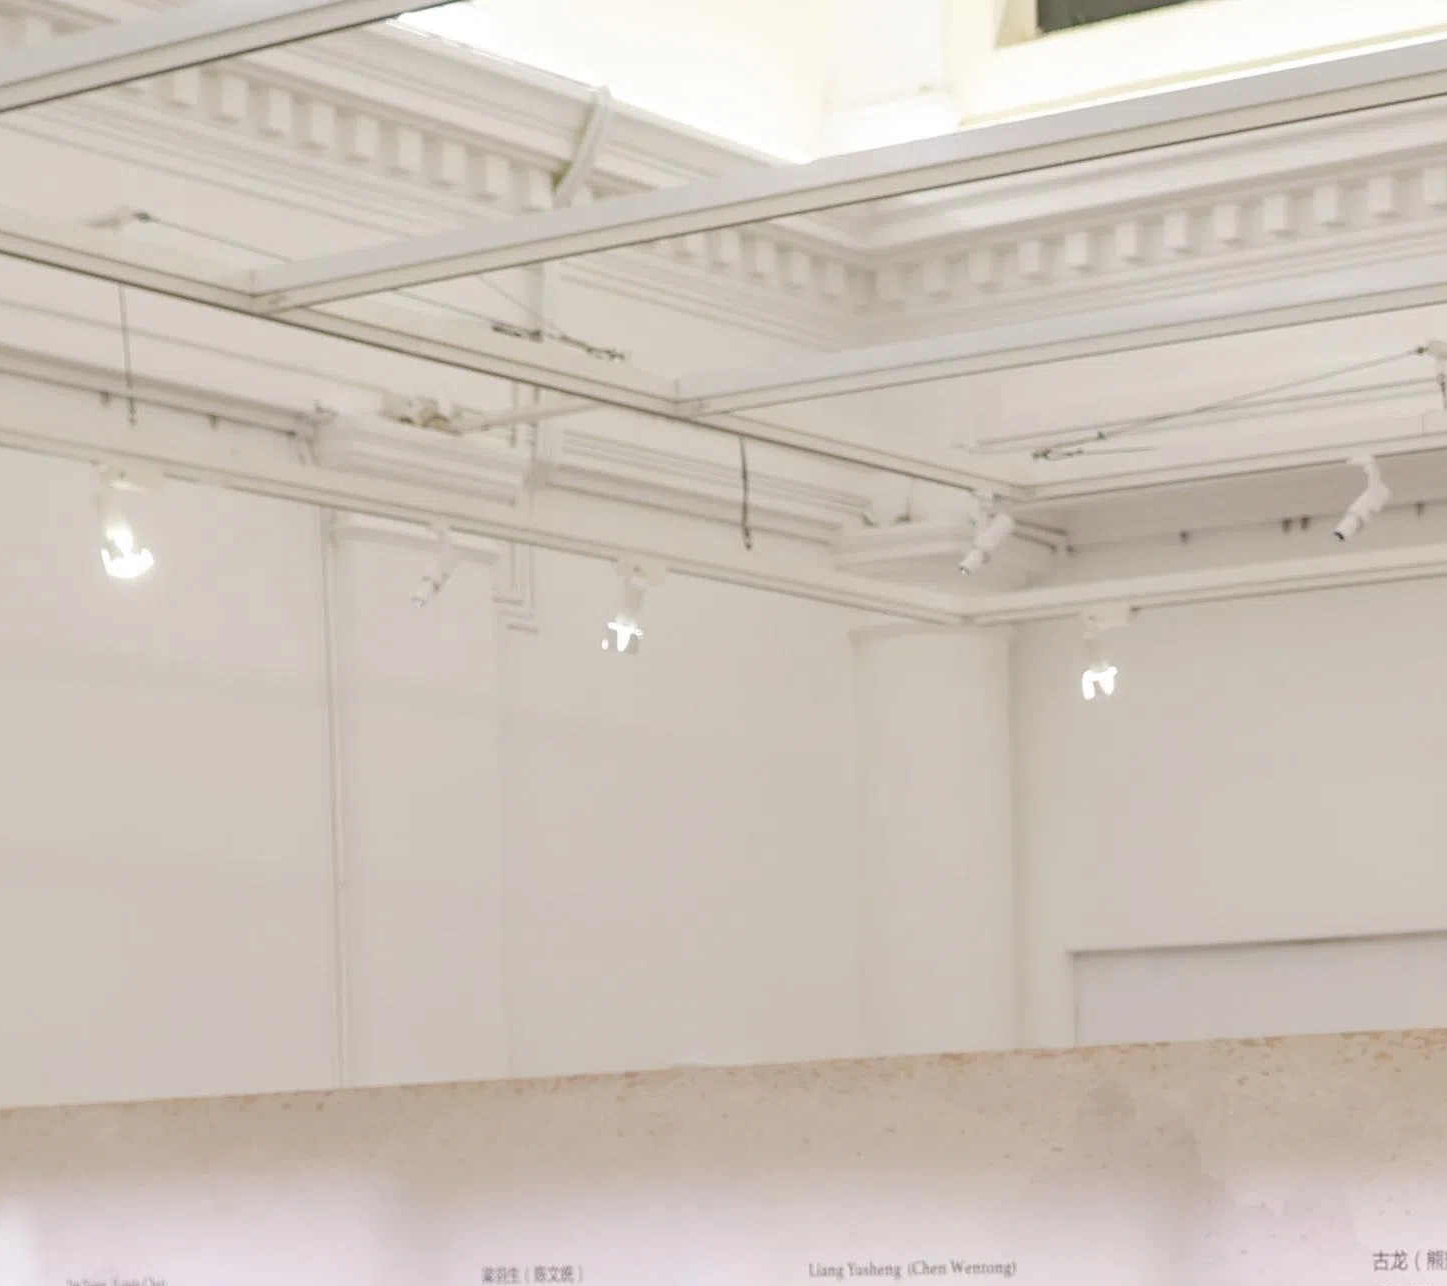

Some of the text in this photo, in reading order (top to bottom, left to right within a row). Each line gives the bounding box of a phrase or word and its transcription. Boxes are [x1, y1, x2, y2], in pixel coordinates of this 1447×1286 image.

[809, 1263, 844, 1279] Liang
[847, 1262, 901, 1279] Yusheng
[907, 1261, 946, 1277] (Chen
